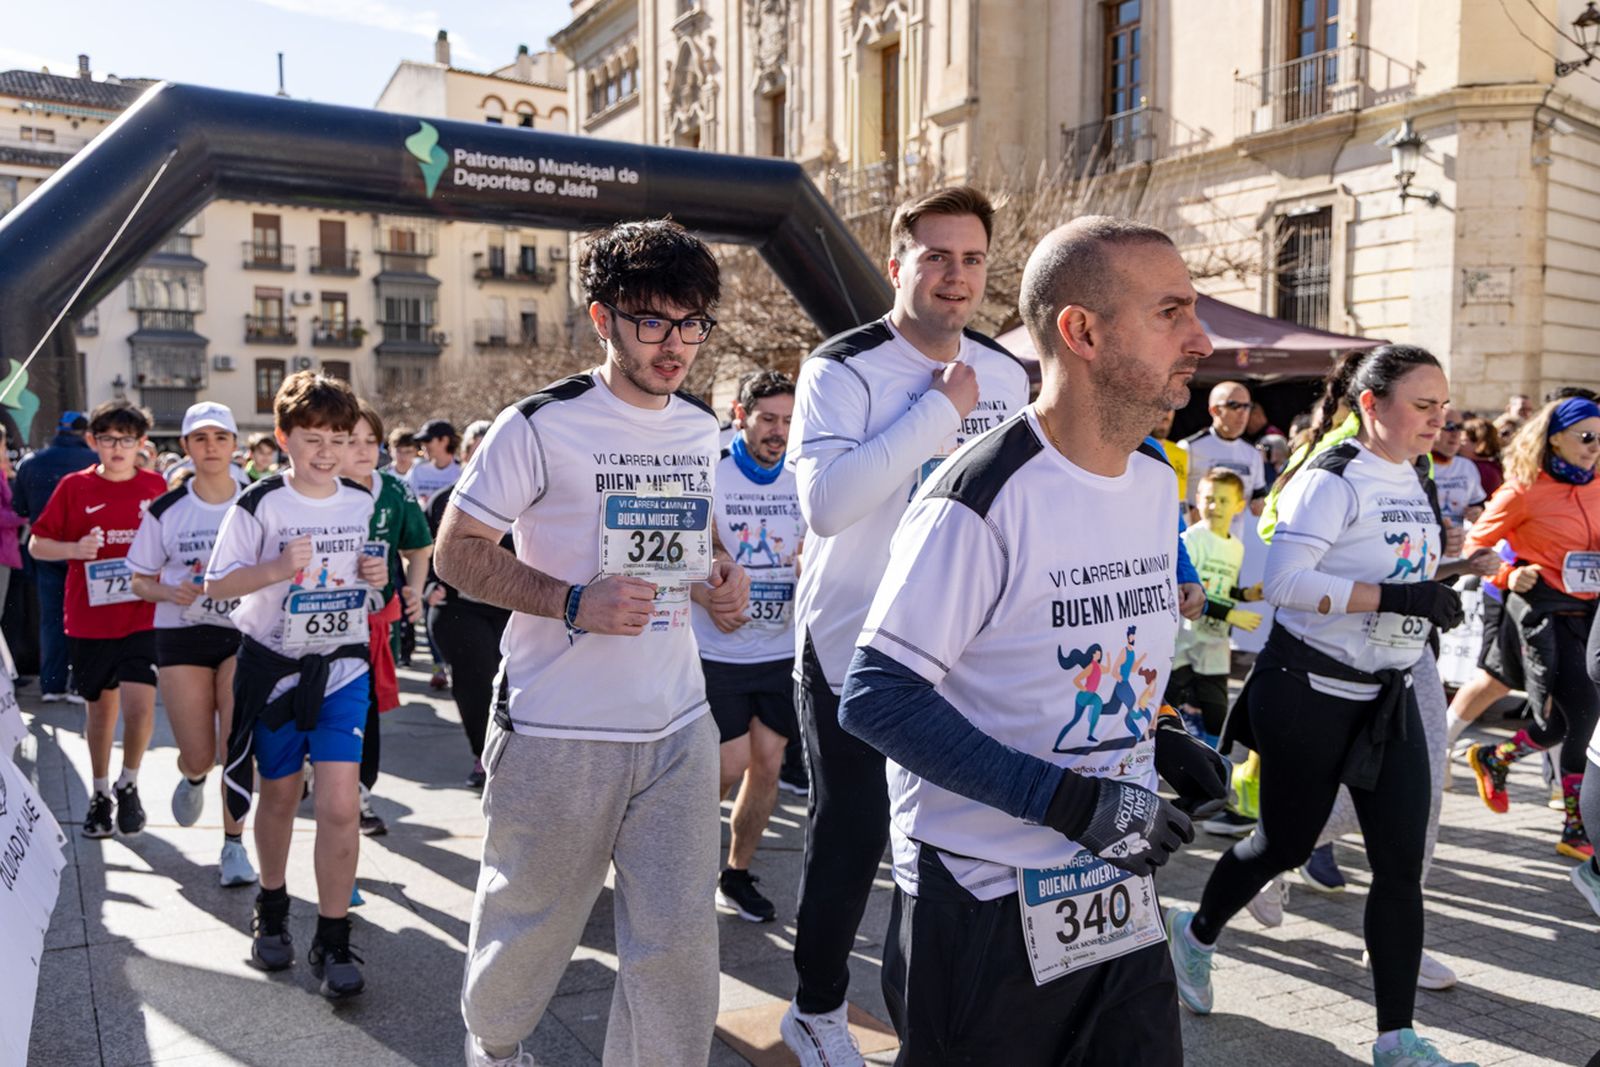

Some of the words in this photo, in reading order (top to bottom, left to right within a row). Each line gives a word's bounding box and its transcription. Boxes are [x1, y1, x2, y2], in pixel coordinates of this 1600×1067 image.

[454, 148, 536, 173] Patronato
[539, 157, 615, 183] Municipal
[618, 168, 639, 184] de
[454, 168, 531, 192] Deportes
[534, 177, 555, 194] de
[558, 178, 598, 199] Jaén
[593, 453, 606, 465] VI
[609, 453, 661, 467] CARRERA
[617, 512, 647, 526] BUENA
[648, 513, 679, 526] MUERTE
[619, 500, 627, 508] VI
[628, 500, 659, 509] CARRERA
[661, 501, 697, 511] CAMINATA
[725, 504, 753, 516] BUENA
[755, 504, 788, 516] MUERTE
[316, 538, 355, 554] MUERTE
[628, 530, 684, 563] 326
[104, 576, 132, 594] 72
[1049, 570, 1067, 588] VI
[1070, 559, 1131, 585] CARRERA
[751, 600, 785, 620] 357
[1052, 594, 1114, 628] BUENA
[1116, 584, 1167, 620] MUERTE
[306, 611, 349, 635] 638
[1116, 785, 1133, 833] ANTÓN
[1133, 789, 1146, 820] SAN
[1038, 873, 1077, 898] BUENA
[1080, 863, 1121, 889] MUERTE
[1055, 883, 1131, 945] 340
